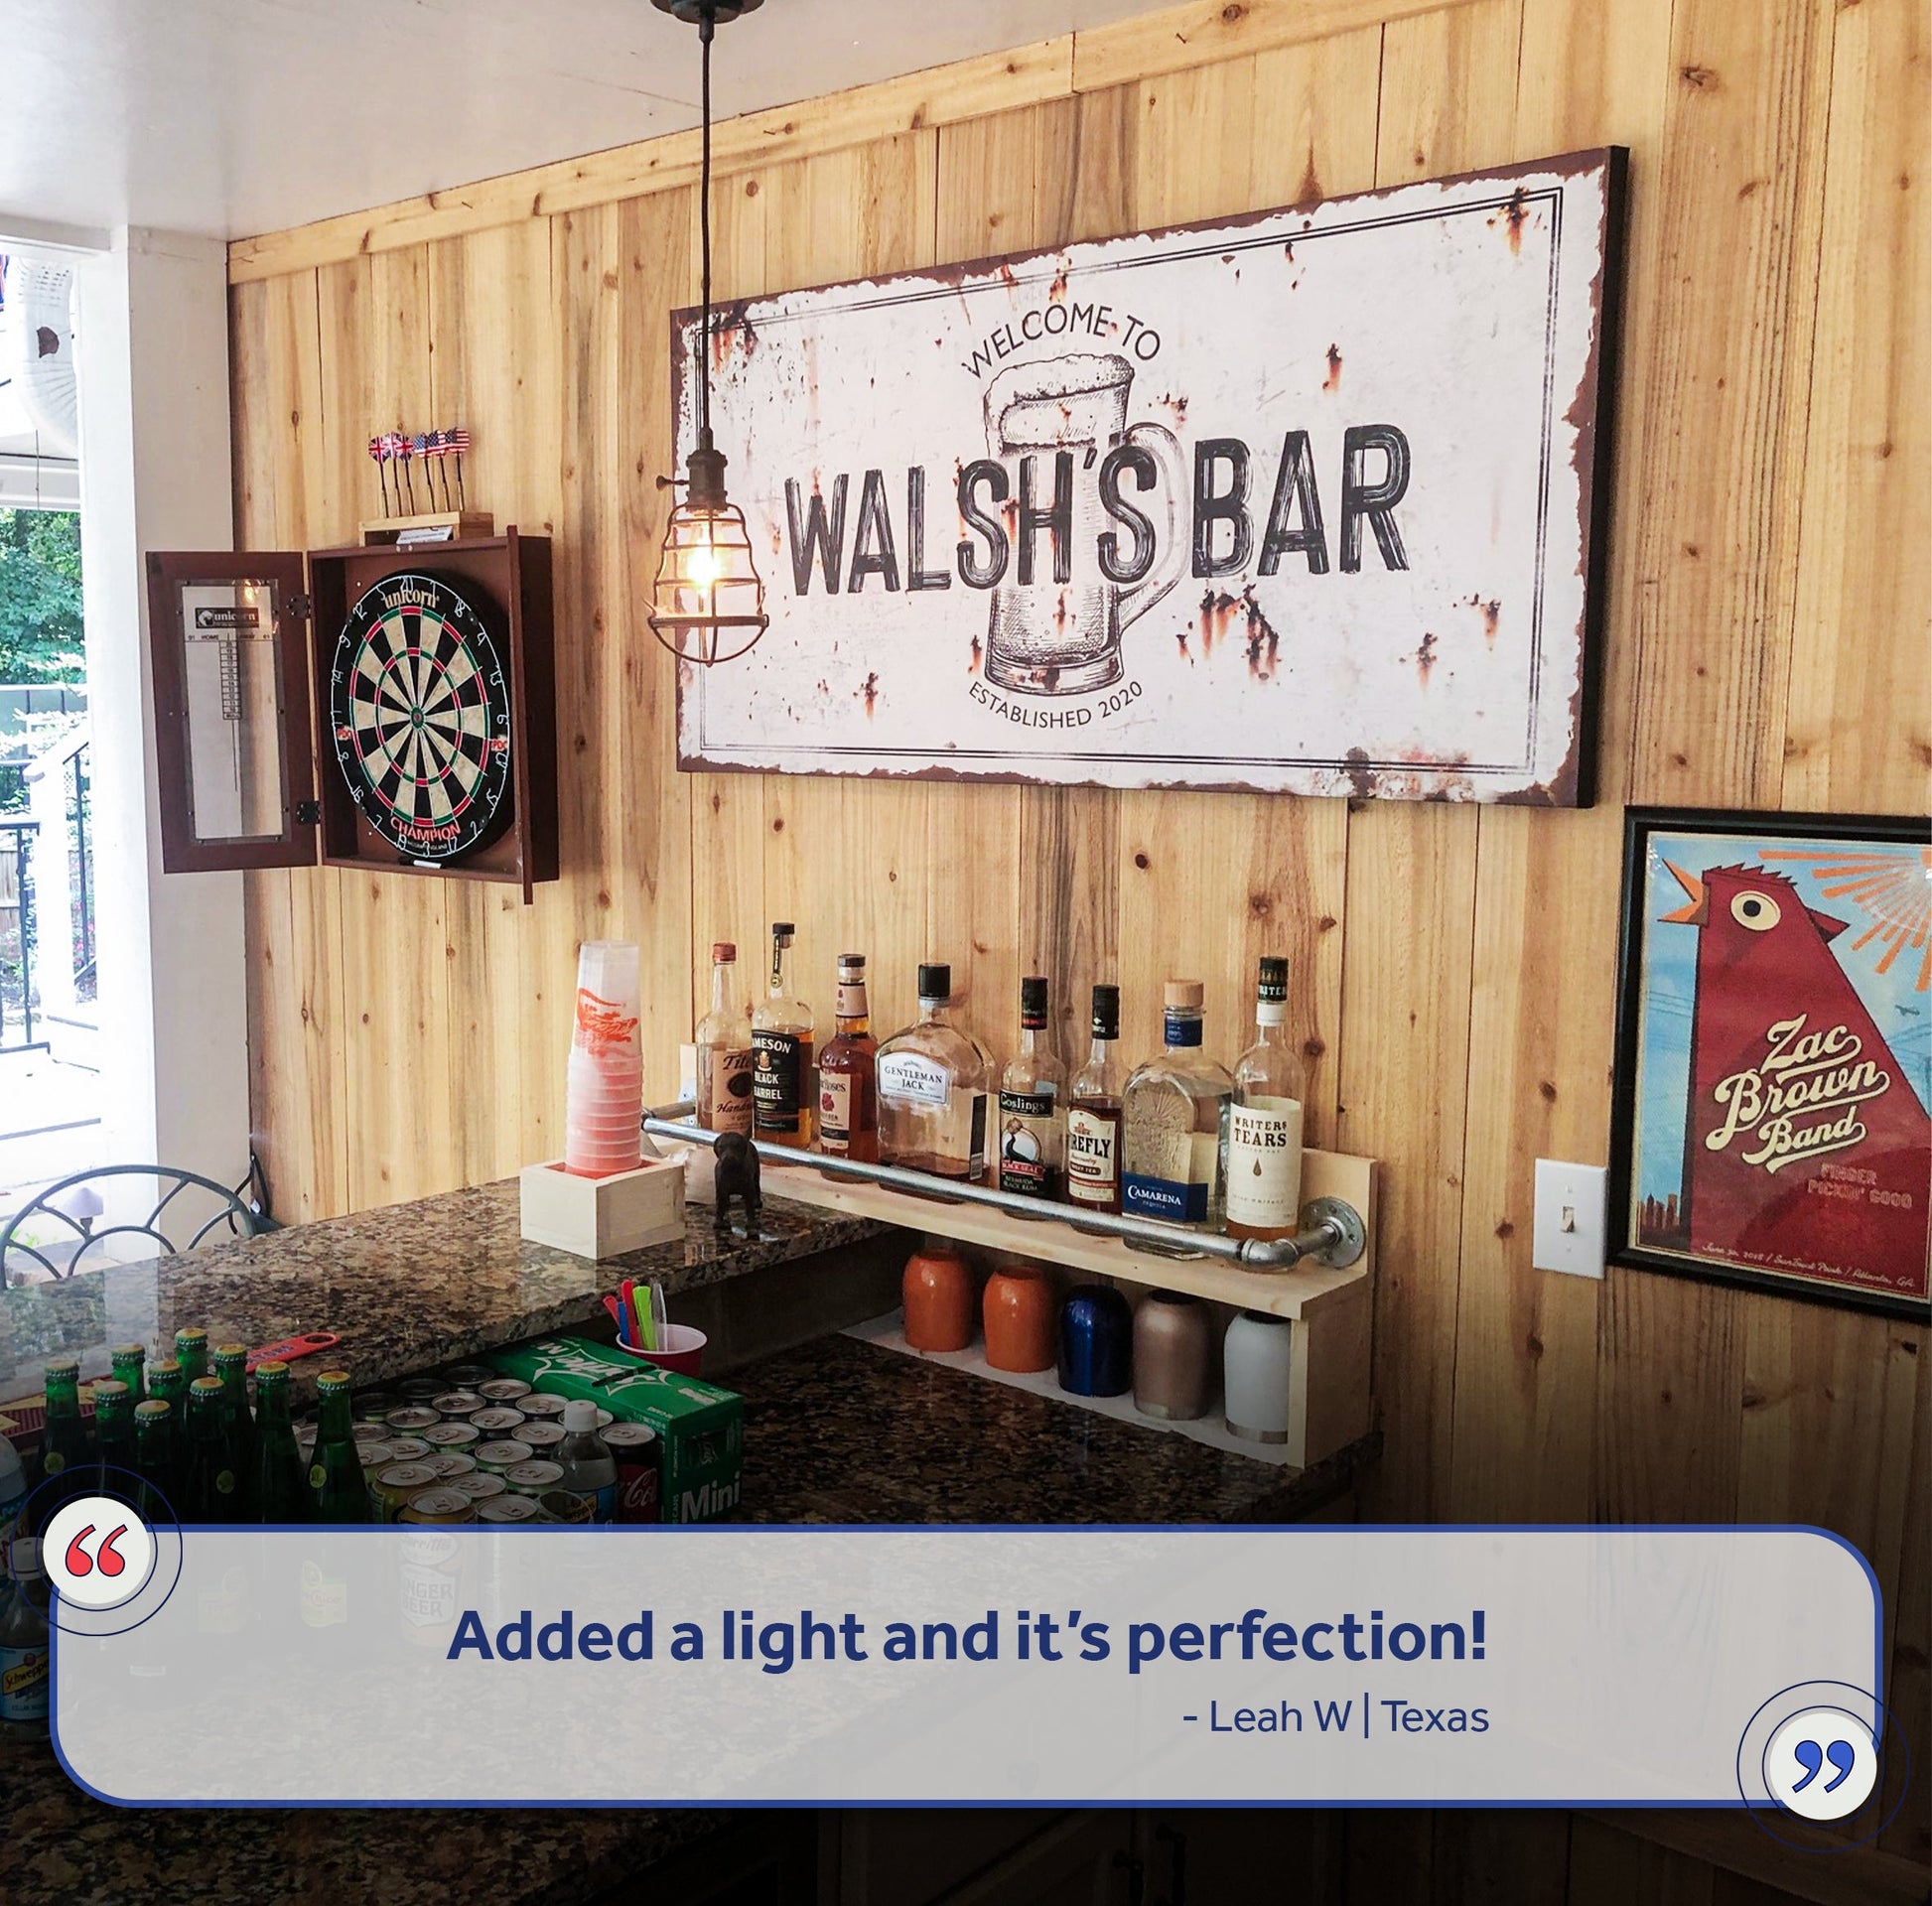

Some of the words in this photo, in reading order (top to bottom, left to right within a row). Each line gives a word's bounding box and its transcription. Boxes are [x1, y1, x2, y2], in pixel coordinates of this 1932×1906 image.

[962, 304, 1111, 379] WELCOME
[1120, 314, 1161, 361] TO
[784, 444, 1158, 596] WALSH'S
[1191, 424, 1411, 578] BAR
[384, 588, 440, 610] unicorn
[968, 681, 1092, 730] ESTABLISHED
[1097, 681, 1144, 719] 2020
[391, 816, 462, 843] CHAMPION
[752, 1036, 792, 1054] AMESON
[1760, 1014, 1863, 1083] Zac
[754, 1071, 779, 1085] BLACK
[885, 1065, 943, 1084] GENTLEMAN
[901, 1078, 924, 1091] JACK
[754, 1085, 783, 1100] BARREL
[1705, 1059, 1890, 1152] Brown
[1234, 1115, 1288, 1132] WRITERS
[1070, 1134, 1112, 1158] REFLY
[1234, 1128, 1288, 1148] TEARS
[1742, 1106, 1866, 1173] Band
[1127, 1184, 1181, 1206] CAMARENA
[681, 1470, 742, 1524] Mini
